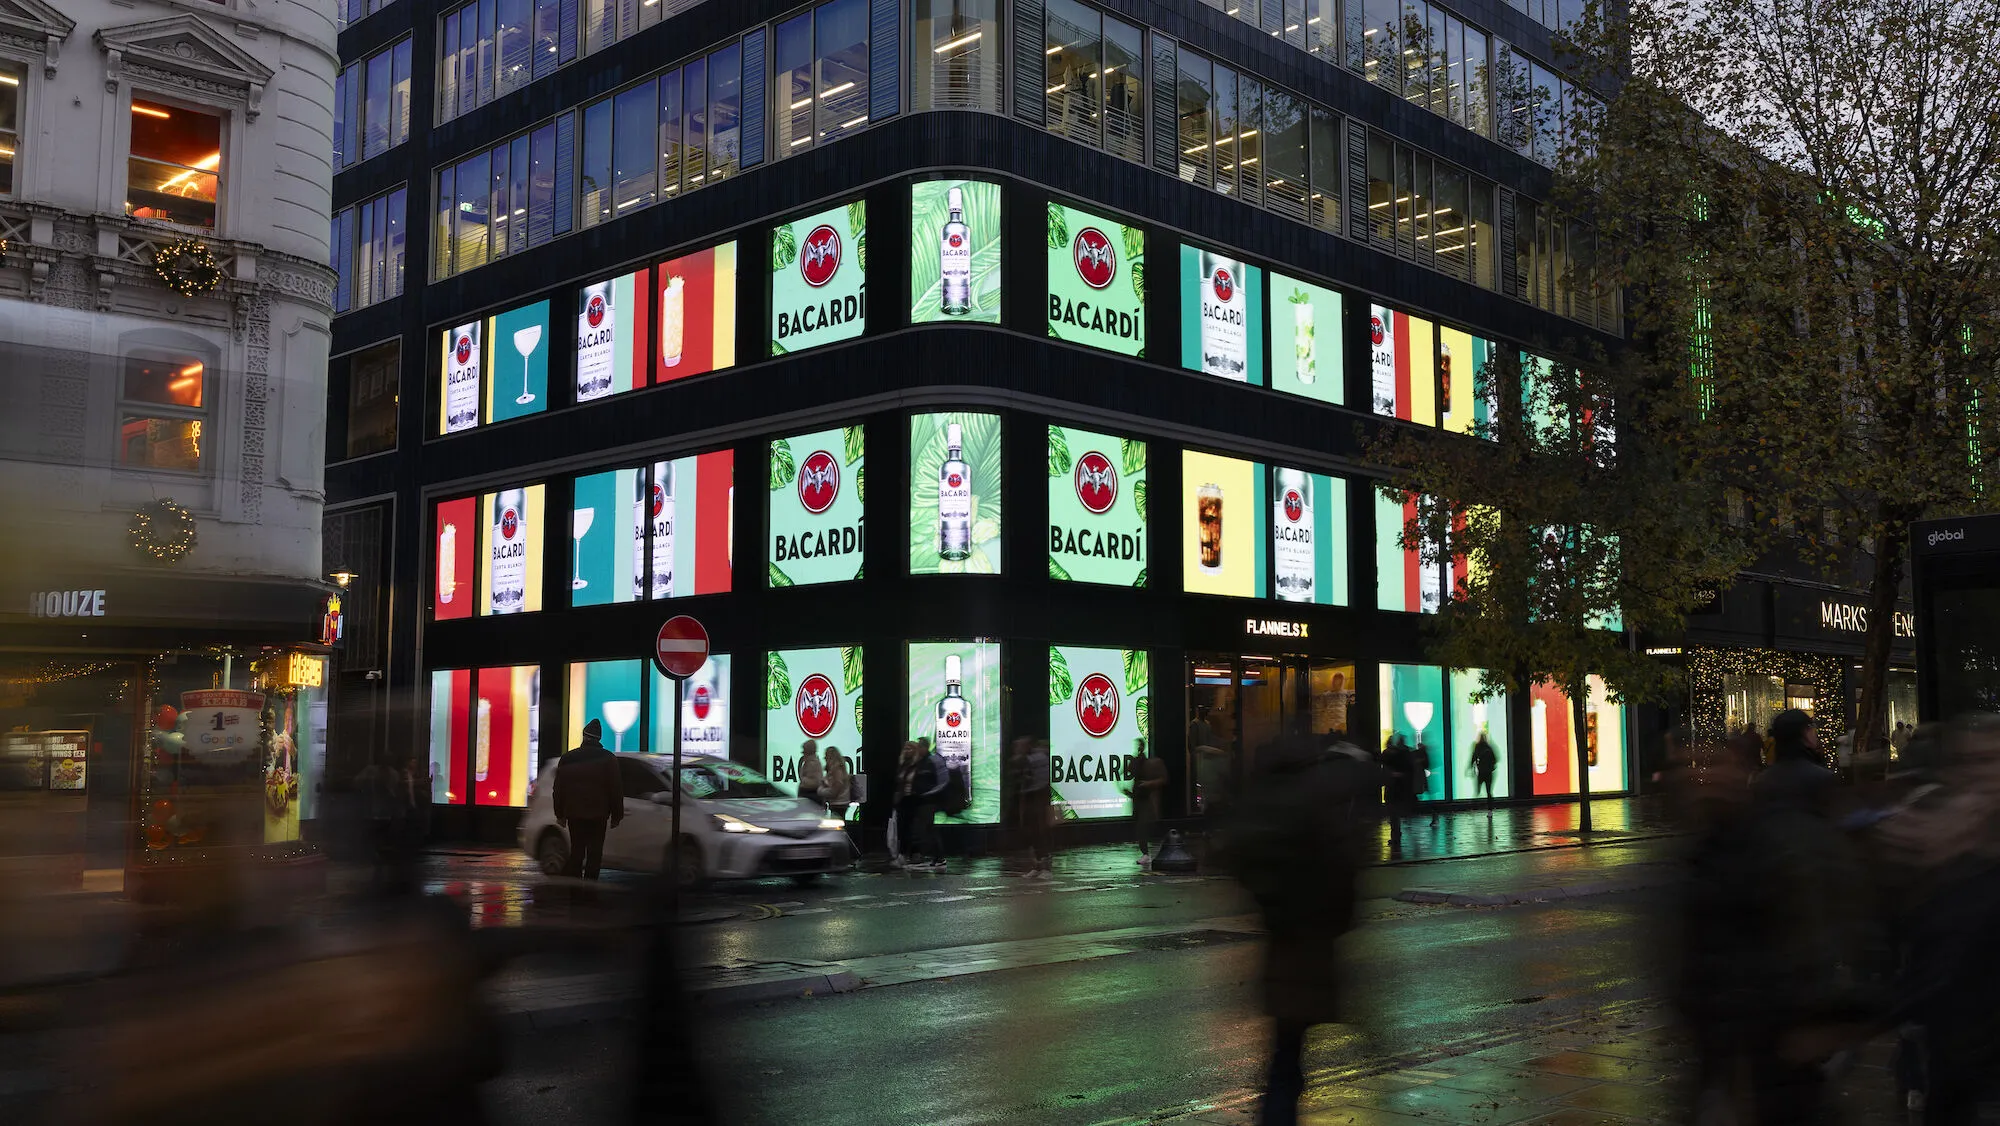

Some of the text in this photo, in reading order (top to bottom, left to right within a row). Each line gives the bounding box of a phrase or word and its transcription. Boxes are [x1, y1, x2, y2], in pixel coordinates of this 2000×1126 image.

[779, 283, 865, 339] BACARDÍ
[1050, 293, 1140, 341] BACARDÍ
[1204, 302, 1244, 327] BACARDÍ
[579, 323, 613, 350] BACARDÍ
[449, 361, 478, 385] BACARDÍ
[635, 516, 673, 540] BAARDÍ
[776, 516, 864, 562] BACARDÍ
[1275, 525, 1312, 544] BACARDÍ
[1928, 528, 1964, 546] global
[493, 538, 525, 560] BACARDÍ
[1051, 525, 1142, 562] BACARDÍ
[30, 590, 106, 618] HOUZE
[1822, 601, 1867, 632] MARKS
[201, 732, 244, 745] Google
[1052, 754, 1135, 783] BACARD
